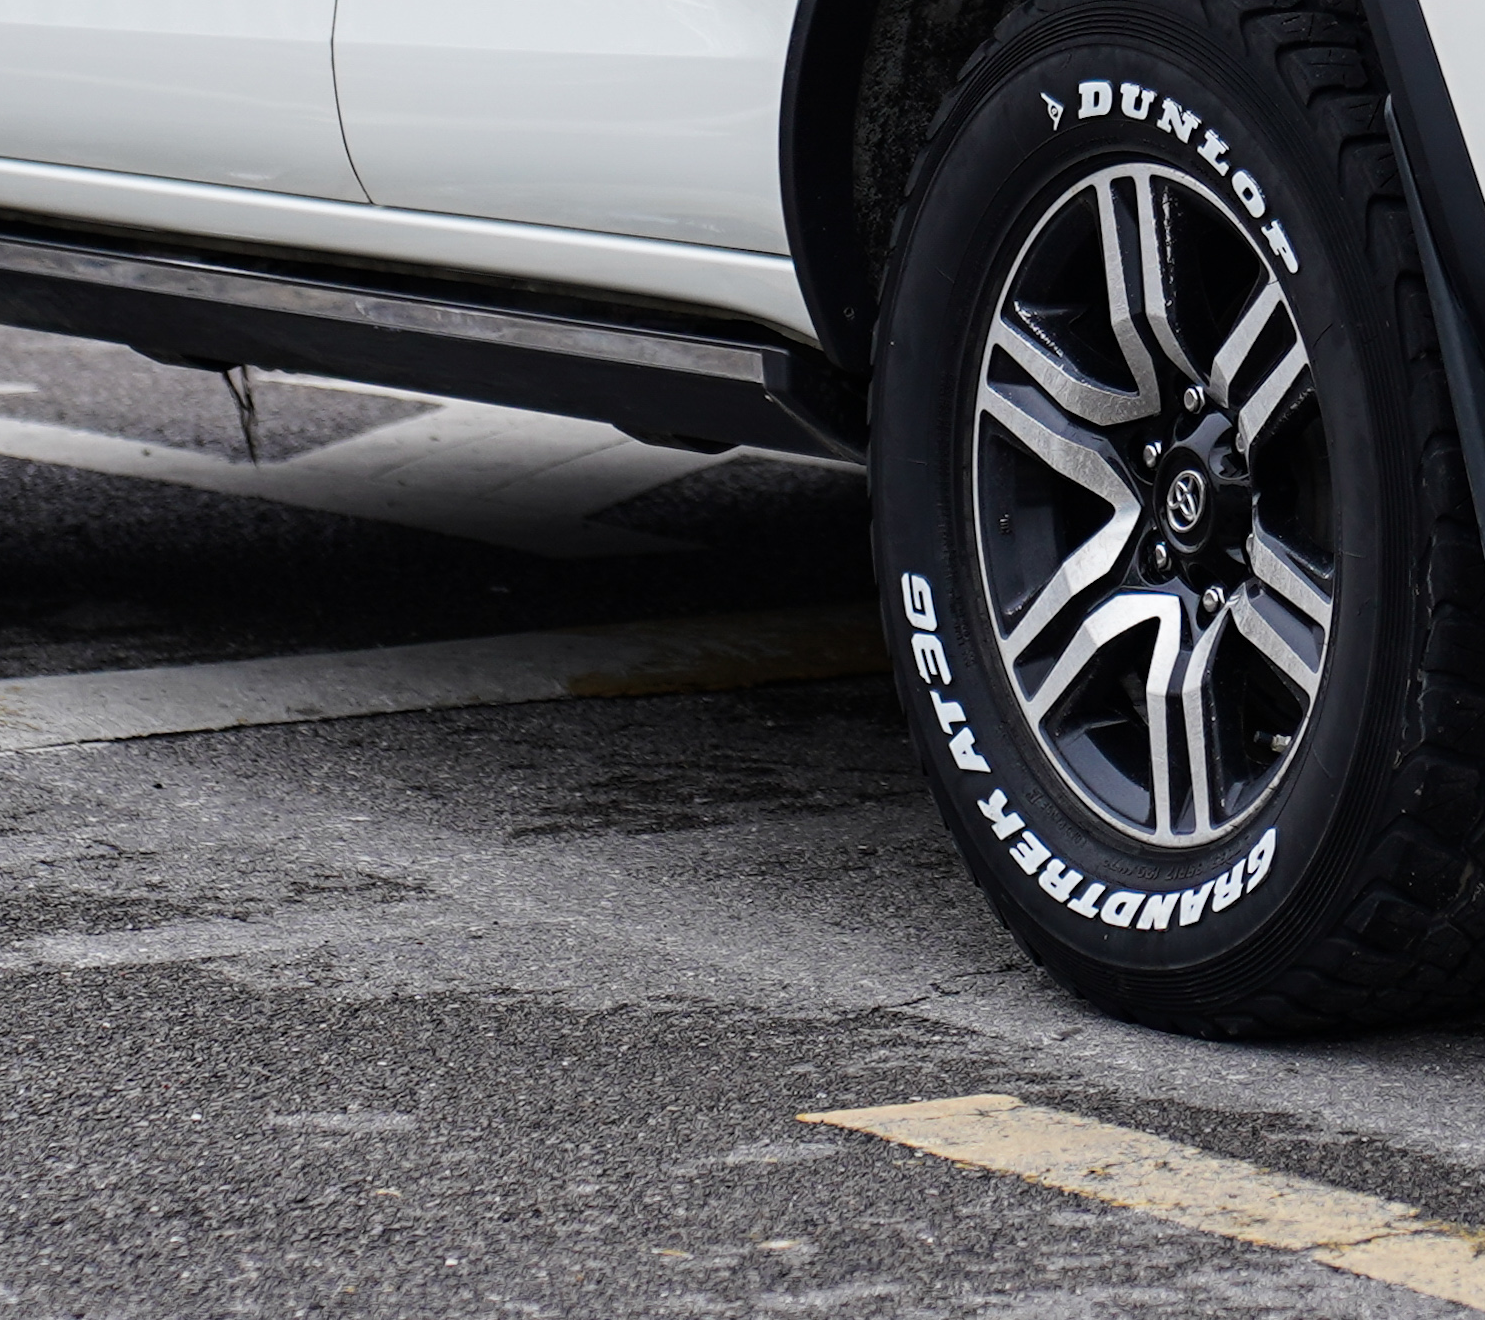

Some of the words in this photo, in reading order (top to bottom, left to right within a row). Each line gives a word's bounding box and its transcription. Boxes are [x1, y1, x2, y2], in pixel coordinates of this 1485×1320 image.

[1077, 79, 1299, 274] DUNLOP
[900, 572, 993, 773] AT3G
[975, 788, 1277, 931] GRANDTREK
